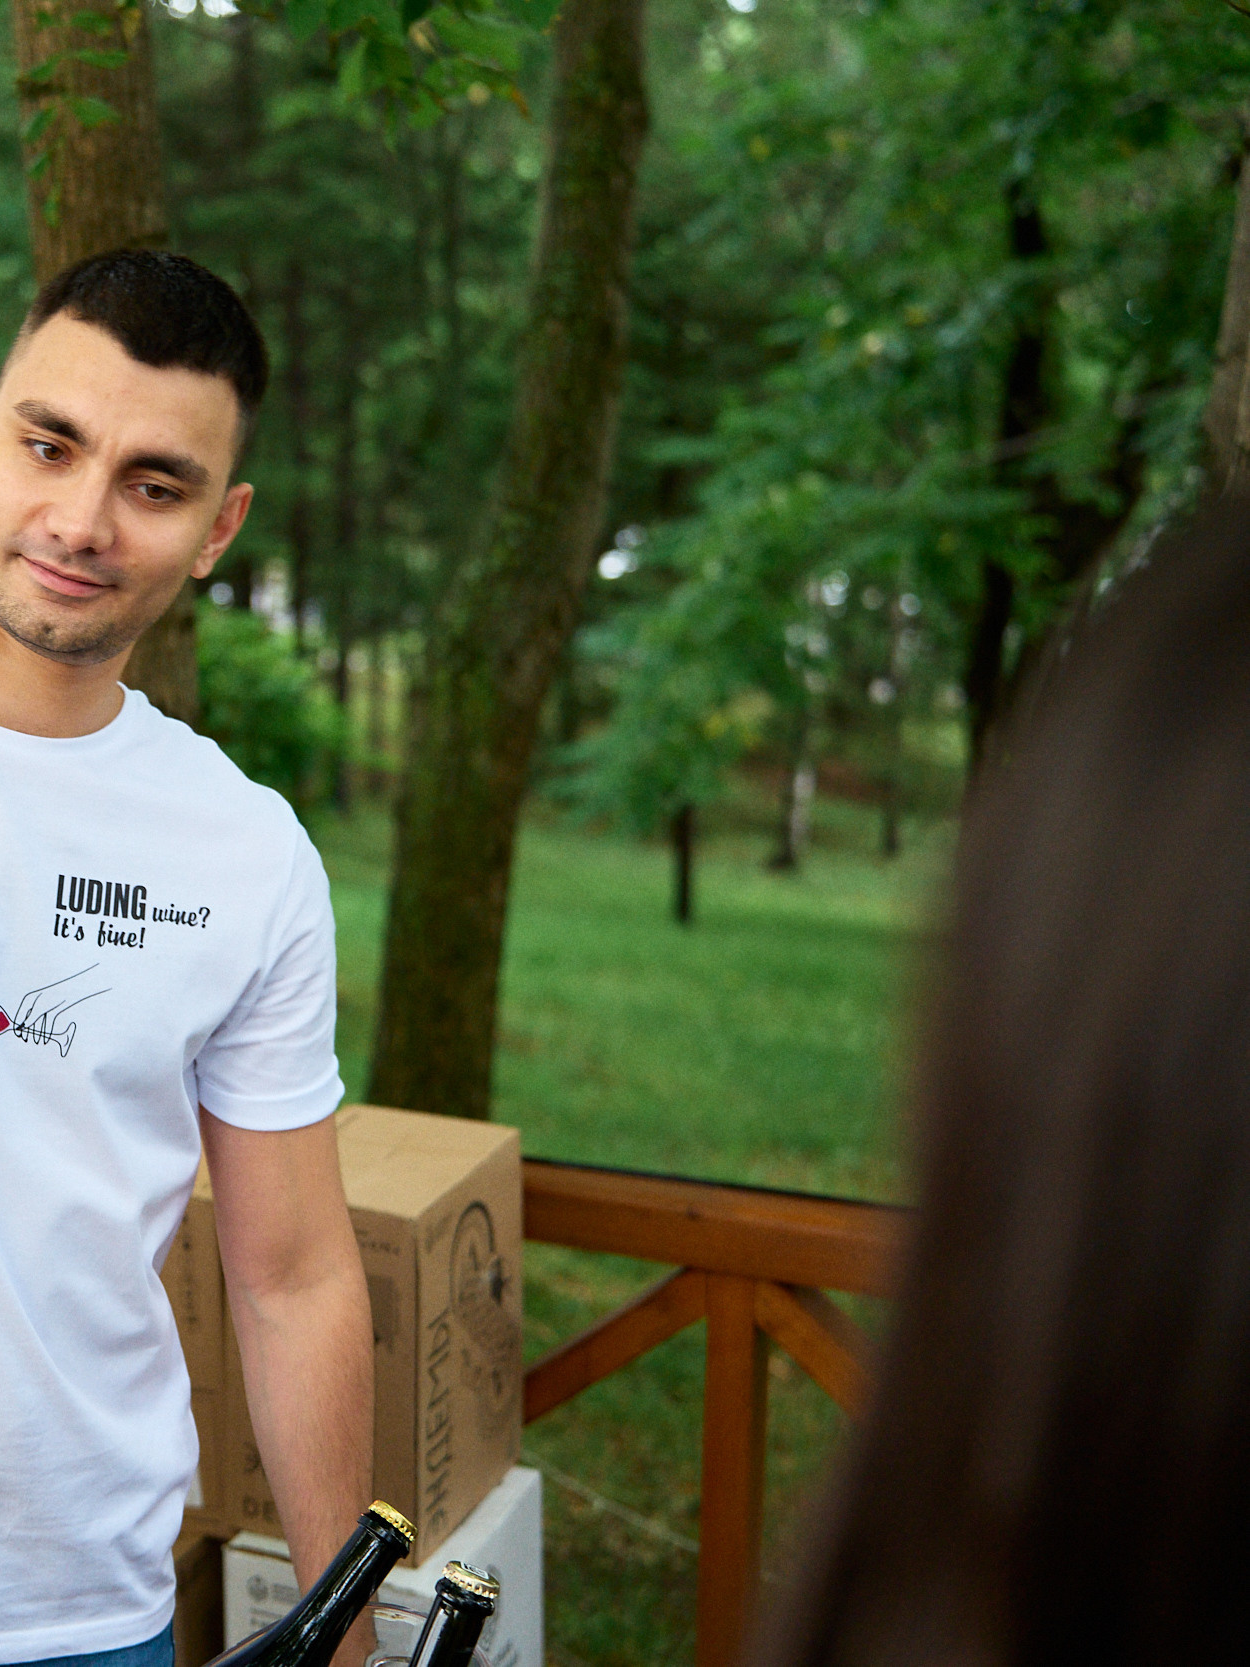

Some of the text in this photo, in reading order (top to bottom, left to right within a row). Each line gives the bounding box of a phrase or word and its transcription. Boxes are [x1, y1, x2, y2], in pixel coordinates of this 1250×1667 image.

[55, 874, 211, 929] LUDING wine?
[53, 913, 146, 949] It's fine!
